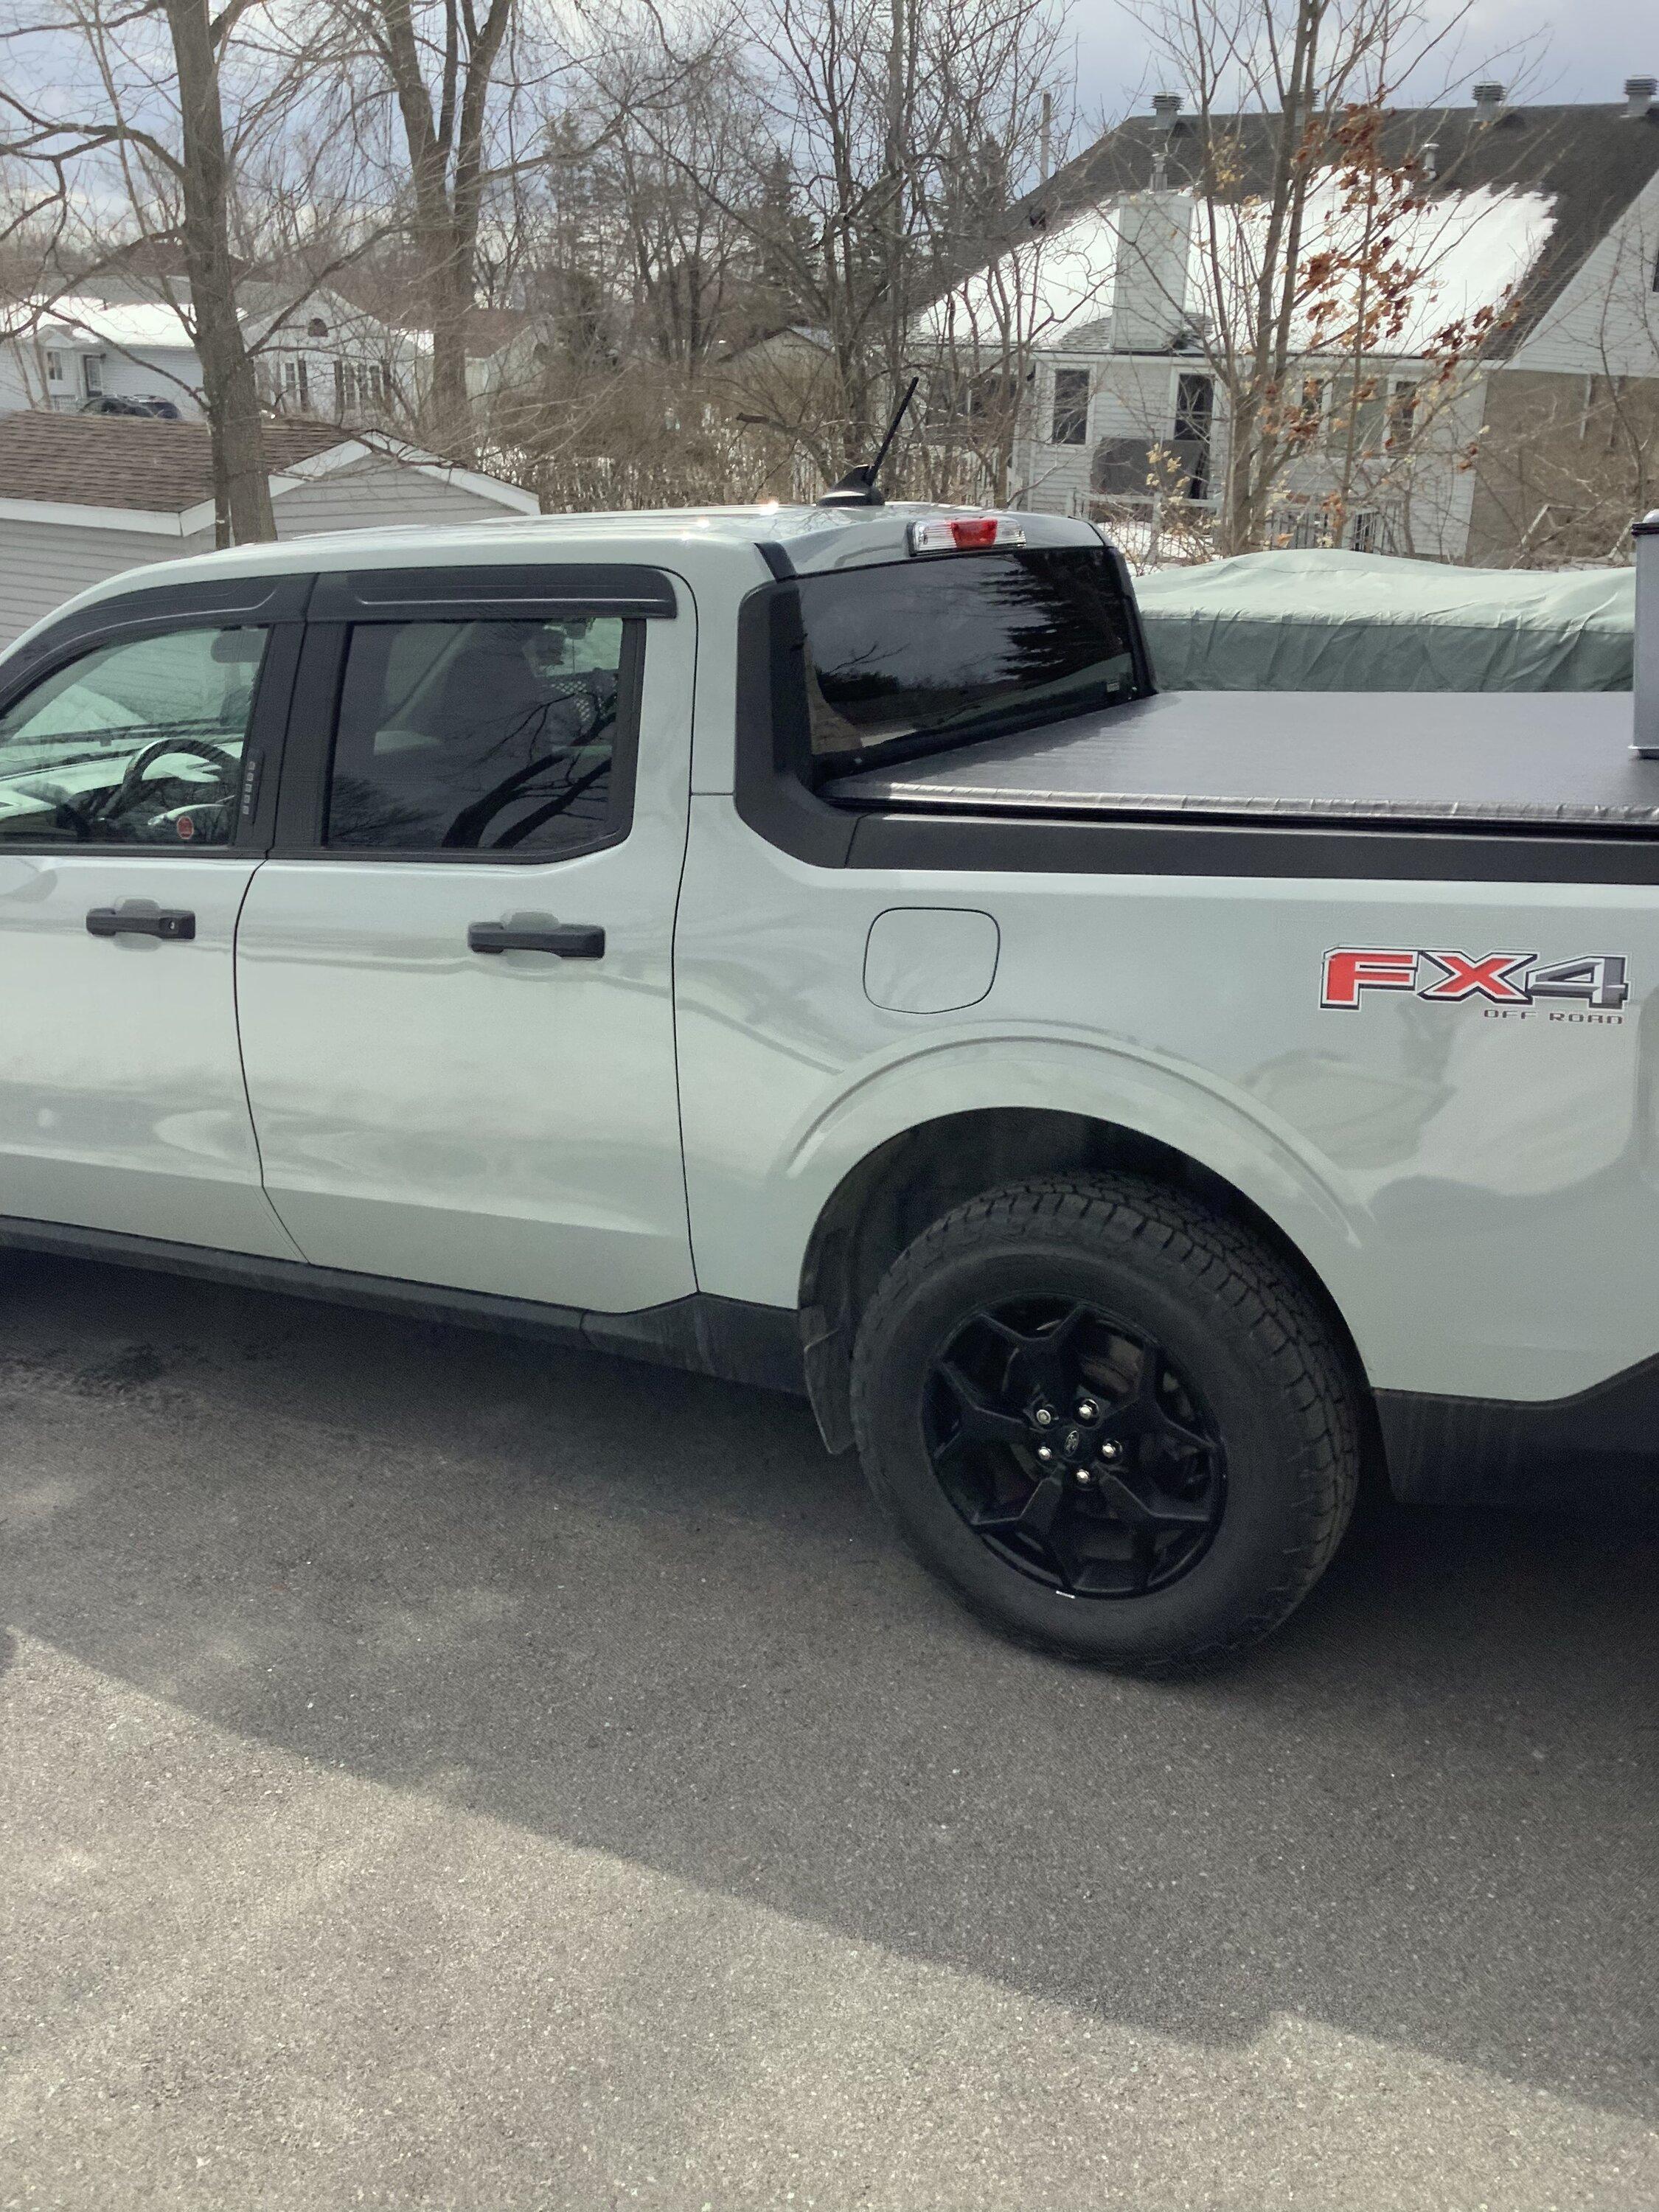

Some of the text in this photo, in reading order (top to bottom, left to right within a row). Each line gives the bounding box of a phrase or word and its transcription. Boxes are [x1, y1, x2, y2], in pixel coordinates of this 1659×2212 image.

[1320, 945, 1629, 1010] FX4
[1484, 1009, 1624, 1025] OFF ROAD
